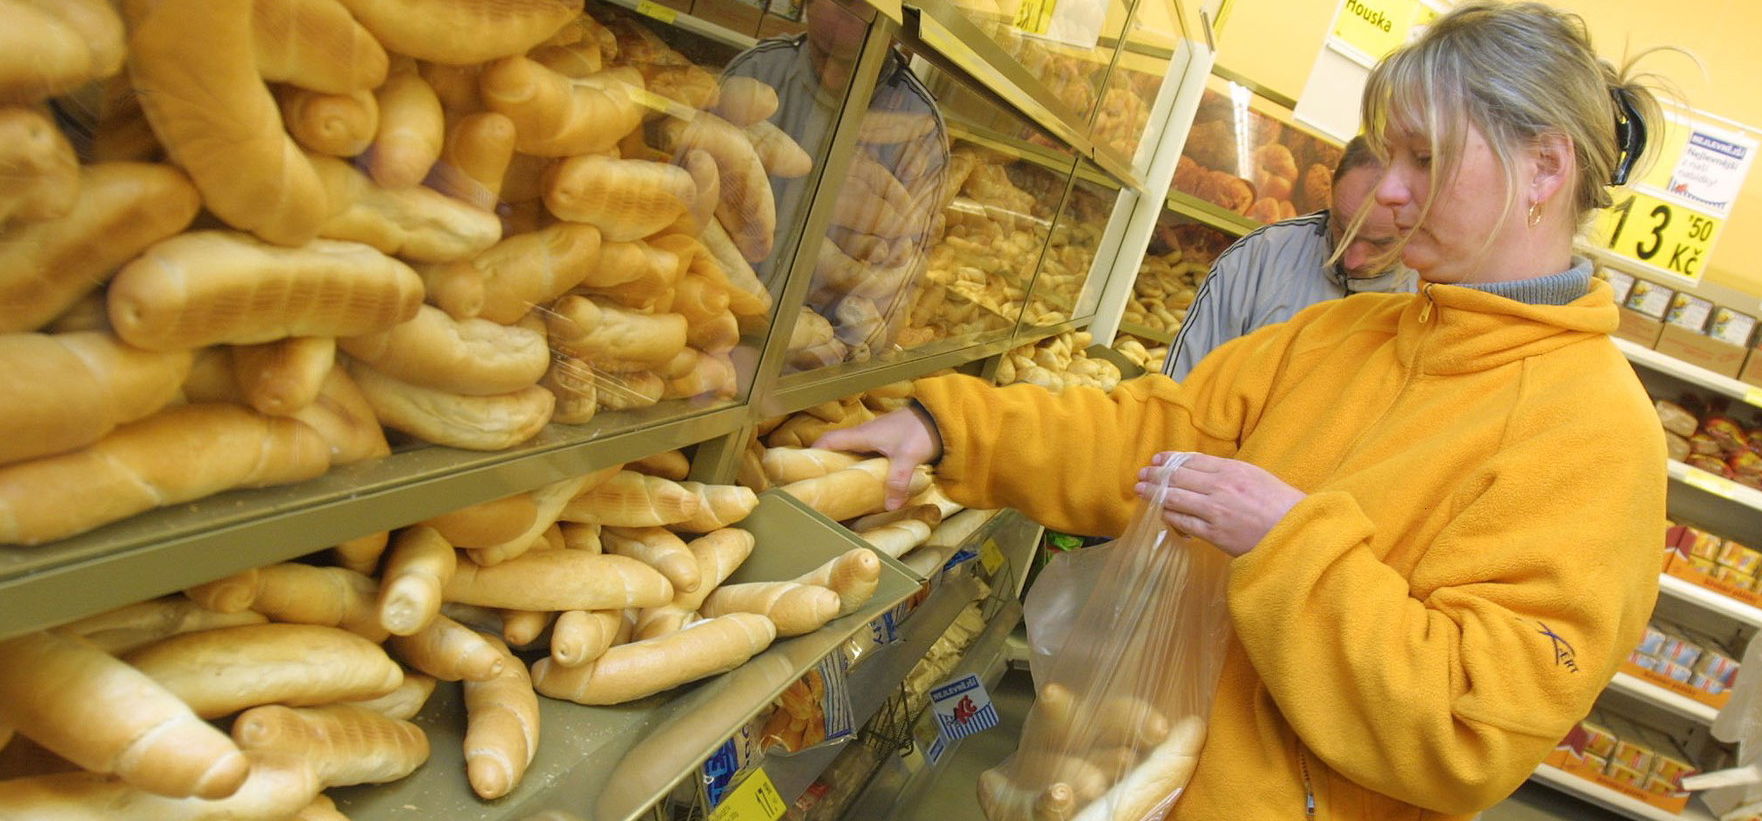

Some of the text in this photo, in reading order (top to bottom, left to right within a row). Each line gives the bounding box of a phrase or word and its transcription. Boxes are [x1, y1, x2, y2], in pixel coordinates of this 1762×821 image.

[1346, 0, 1392, 33] Houska
[1608, 195, 1672, 261] 13
[1668, 243, 1703, 275] Kč
